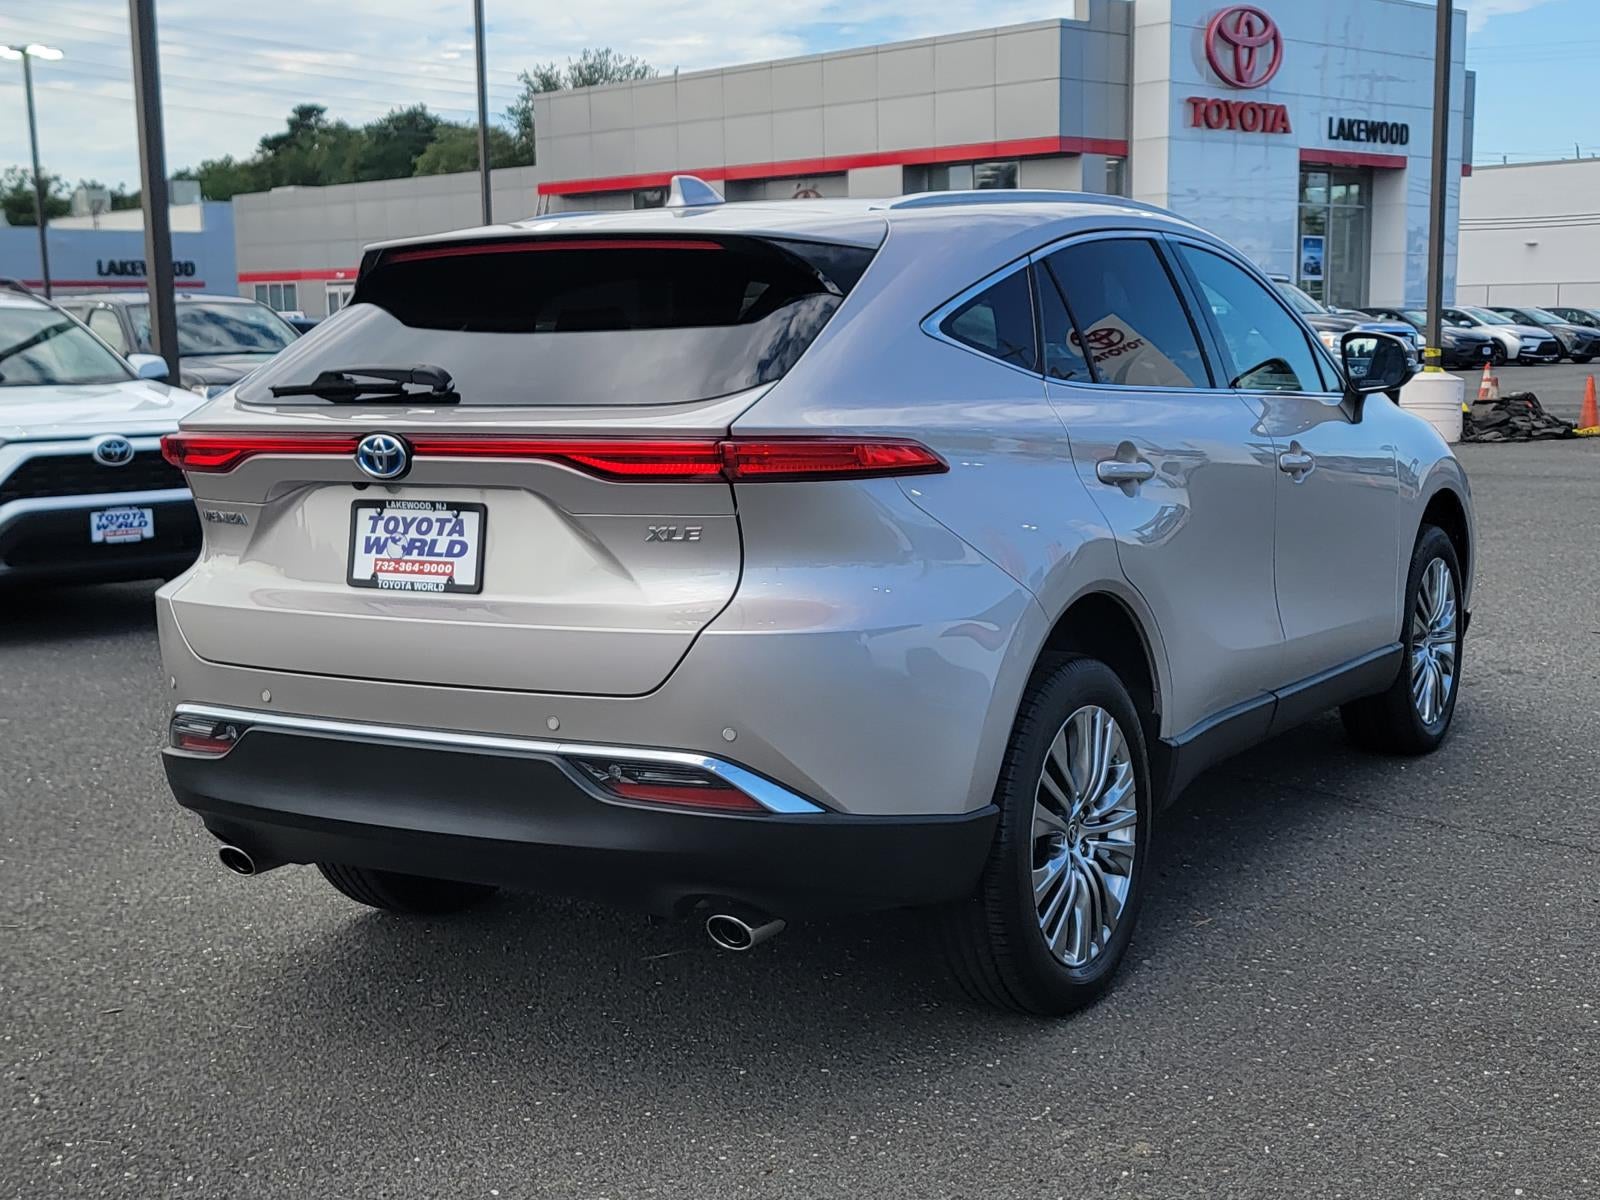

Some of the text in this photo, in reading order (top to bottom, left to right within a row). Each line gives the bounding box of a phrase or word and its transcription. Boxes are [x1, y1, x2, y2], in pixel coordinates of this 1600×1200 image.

[1185, 97, 1292, 134] TOYOTA
[1328, 117, 1409, 145] LAKEWOOD
[97, 259, 196, 277] LAKEOD
[386, 501, 447, 512] LAKEWOOD, NJ
[97, 510, 146, 522] TOYOTA
[368, 515, 465, 537] TOYOTA
[645, 526, 702, 541] XLE
[376, 560, 452, 573] 732-364-9000
[378, 579, 445, 592] TOYOTA WORLD
